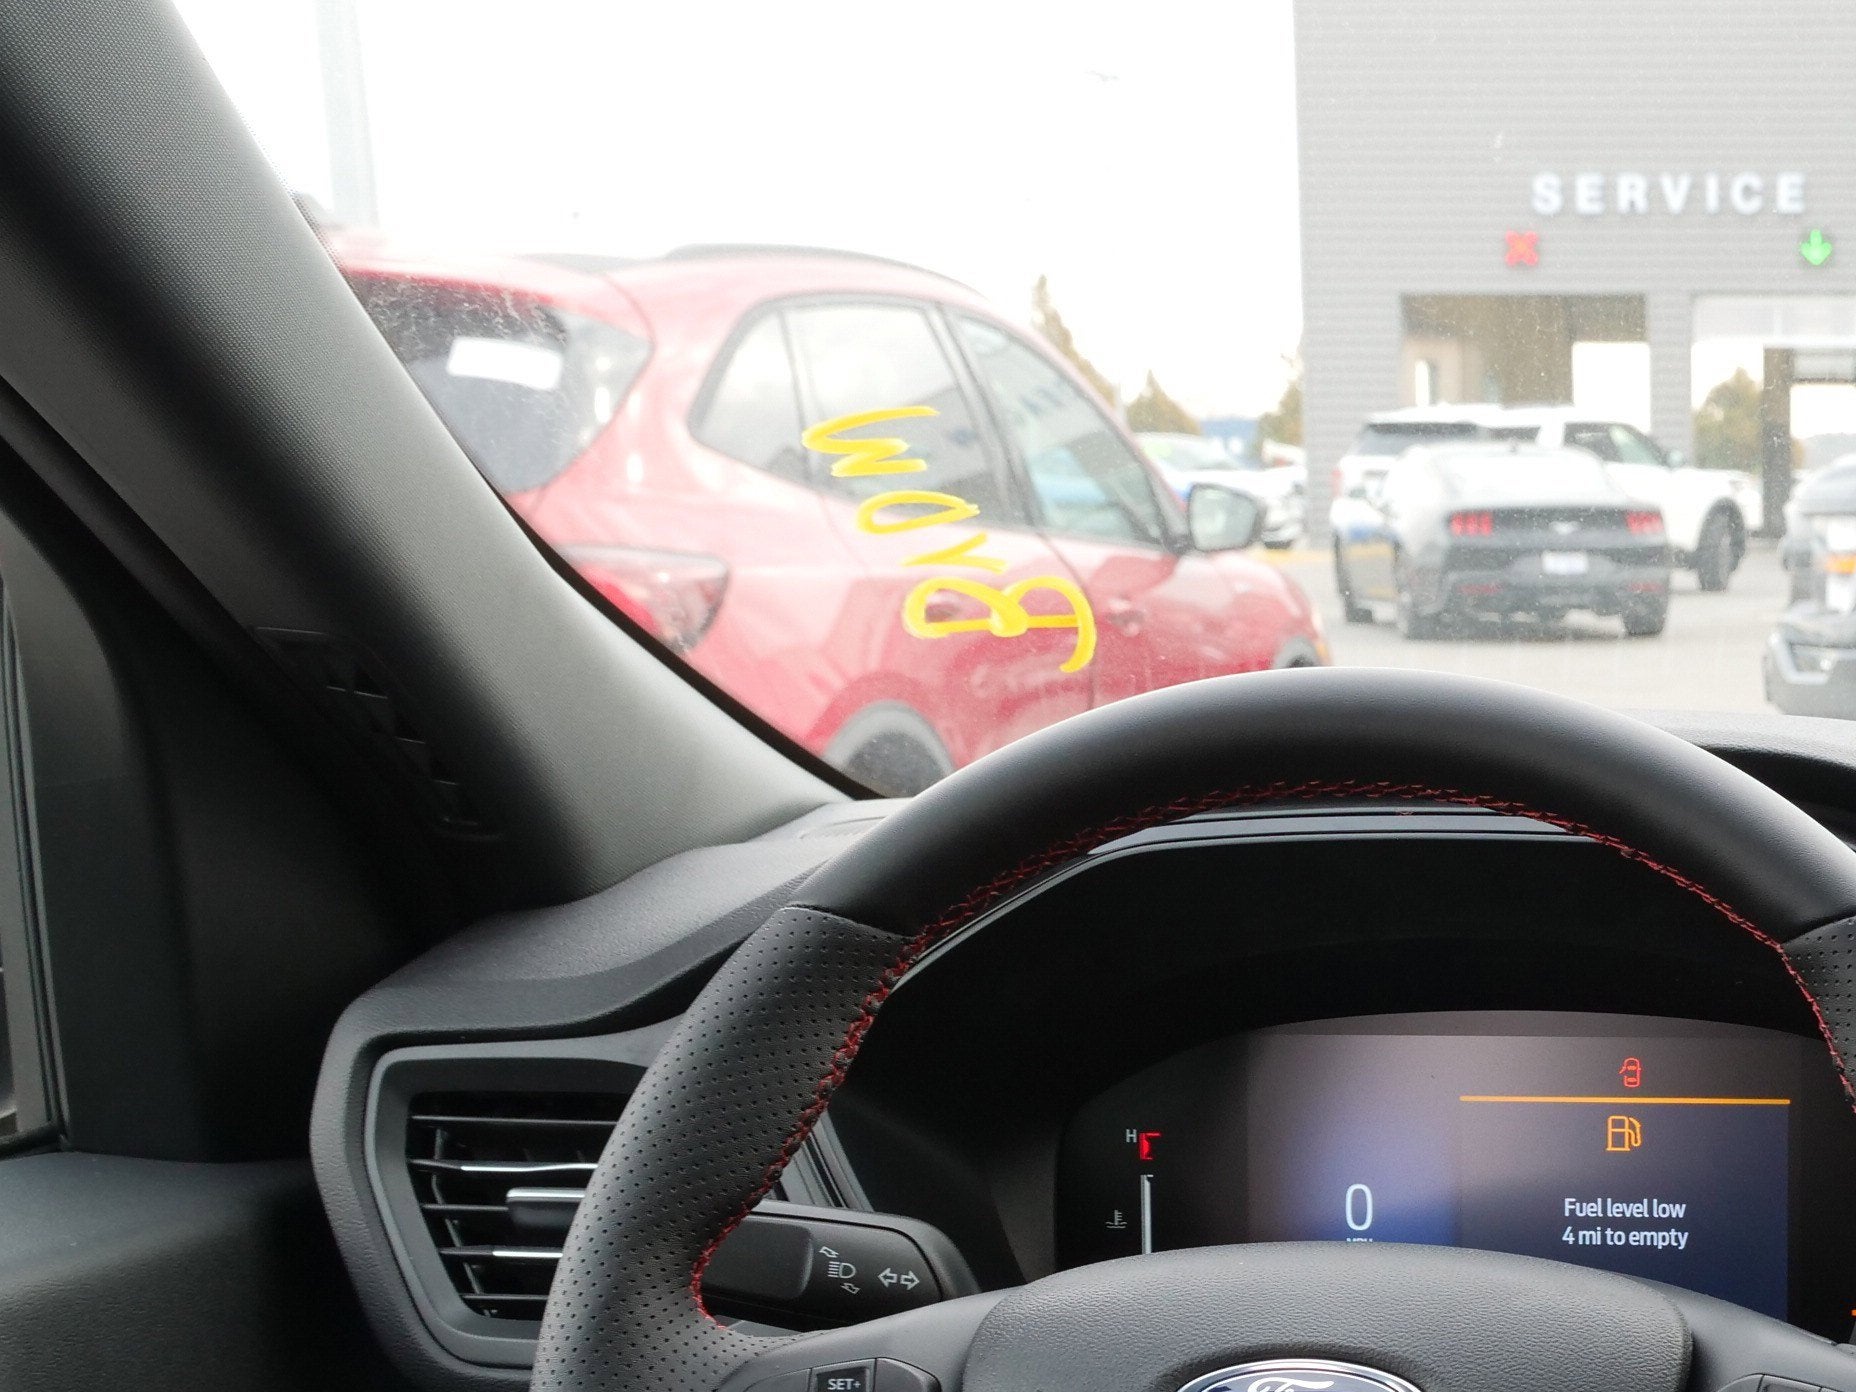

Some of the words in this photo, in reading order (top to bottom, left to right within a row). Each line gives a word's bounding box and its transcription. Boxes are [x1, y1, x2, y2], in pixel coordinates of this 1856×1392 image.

[1532, 172, 1807, 214] SERVICE
[1126, 1129, 1137, 1143] H
[1345, 1183, 1373, 1231] 0
[1564, 1197, 1604, 1218] Fuel
[1606, 1197, 1650, 1218] level
[1652, 1198, 1687, 1219] low
[1561, 1225, 1576, 1245] 4
[1578, 1226, 1602, 1245] mi
[1604, 1227, 1626, 1246] to
[1628, 1228, 1689, 1250] empty
